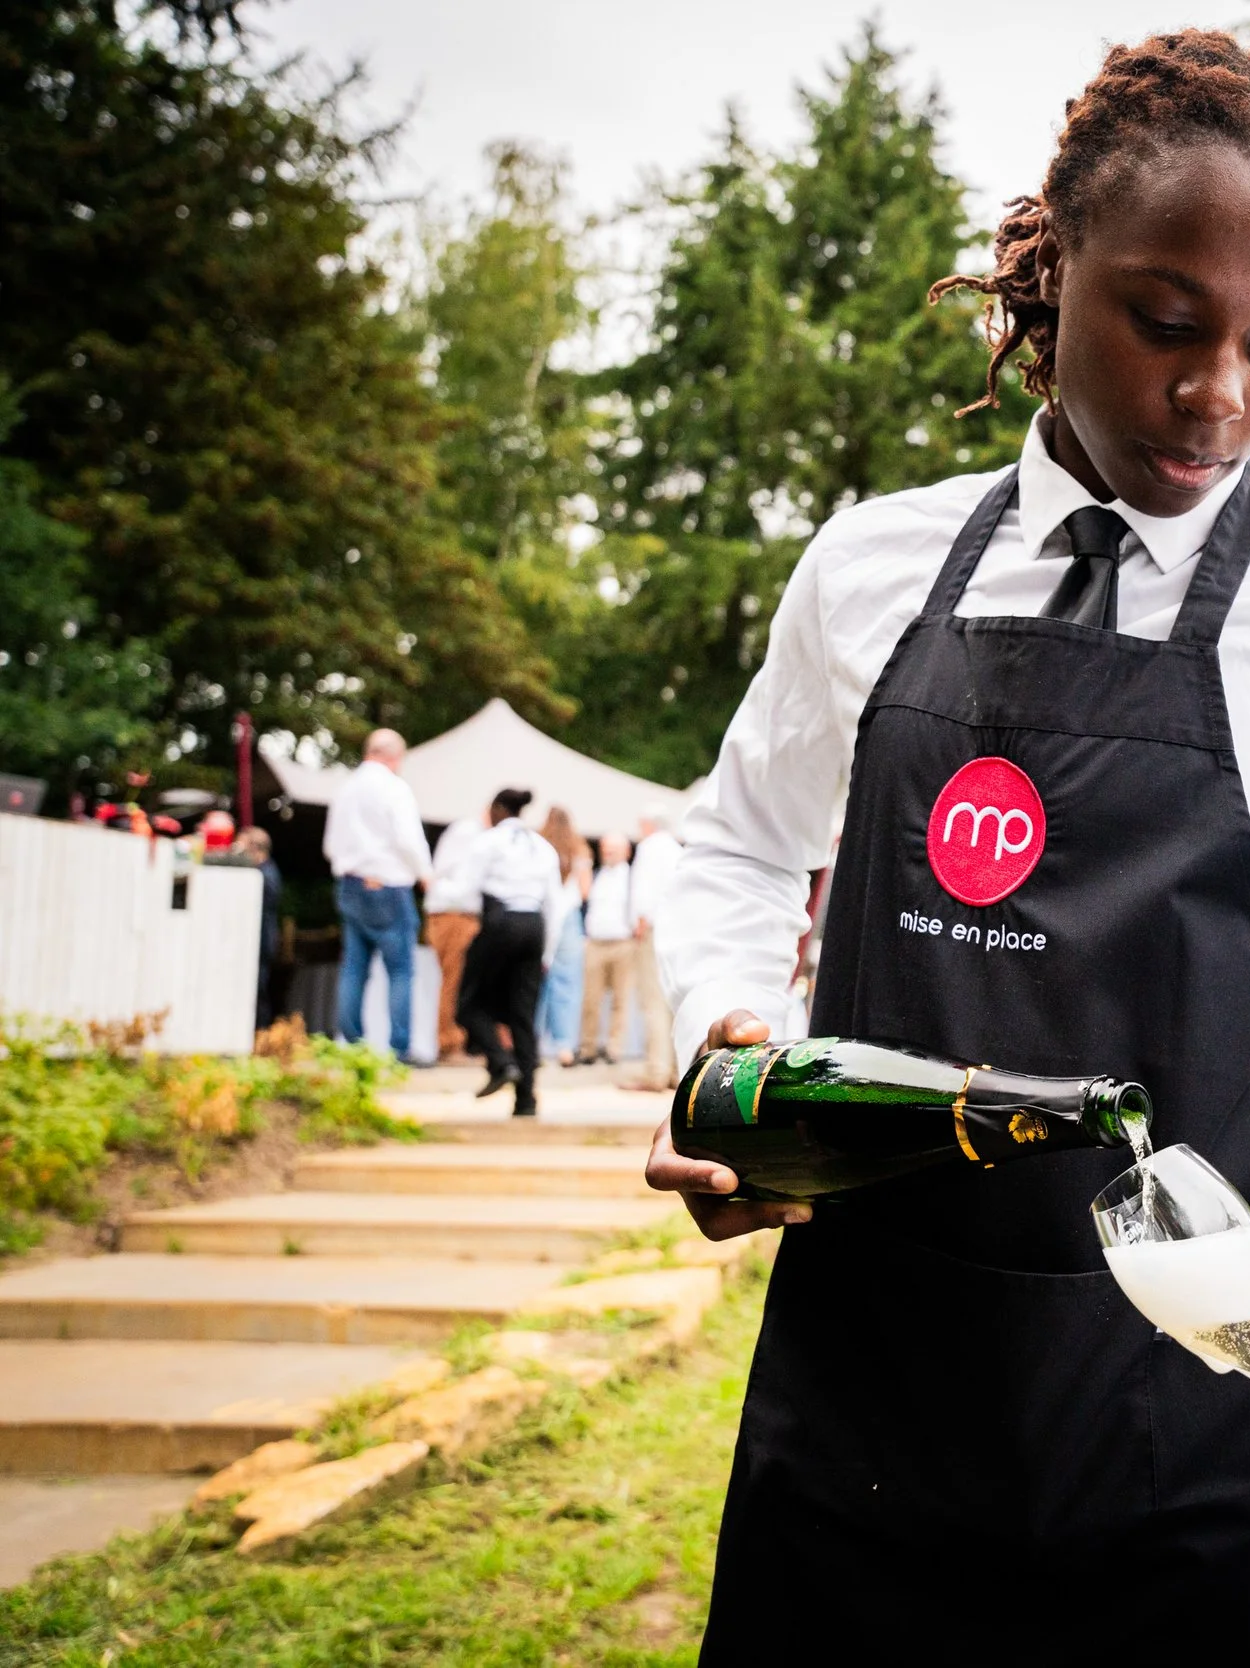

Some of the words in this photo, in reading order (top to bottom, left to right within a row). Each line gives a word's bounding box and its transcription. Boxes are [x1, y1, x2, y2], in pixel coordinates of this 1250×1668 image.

[943, 802, 1034, 861] mp
[899, 909, 944, 936] mise
[951, 923, 982, 944] en
[986, 923, 1047, 952] place
